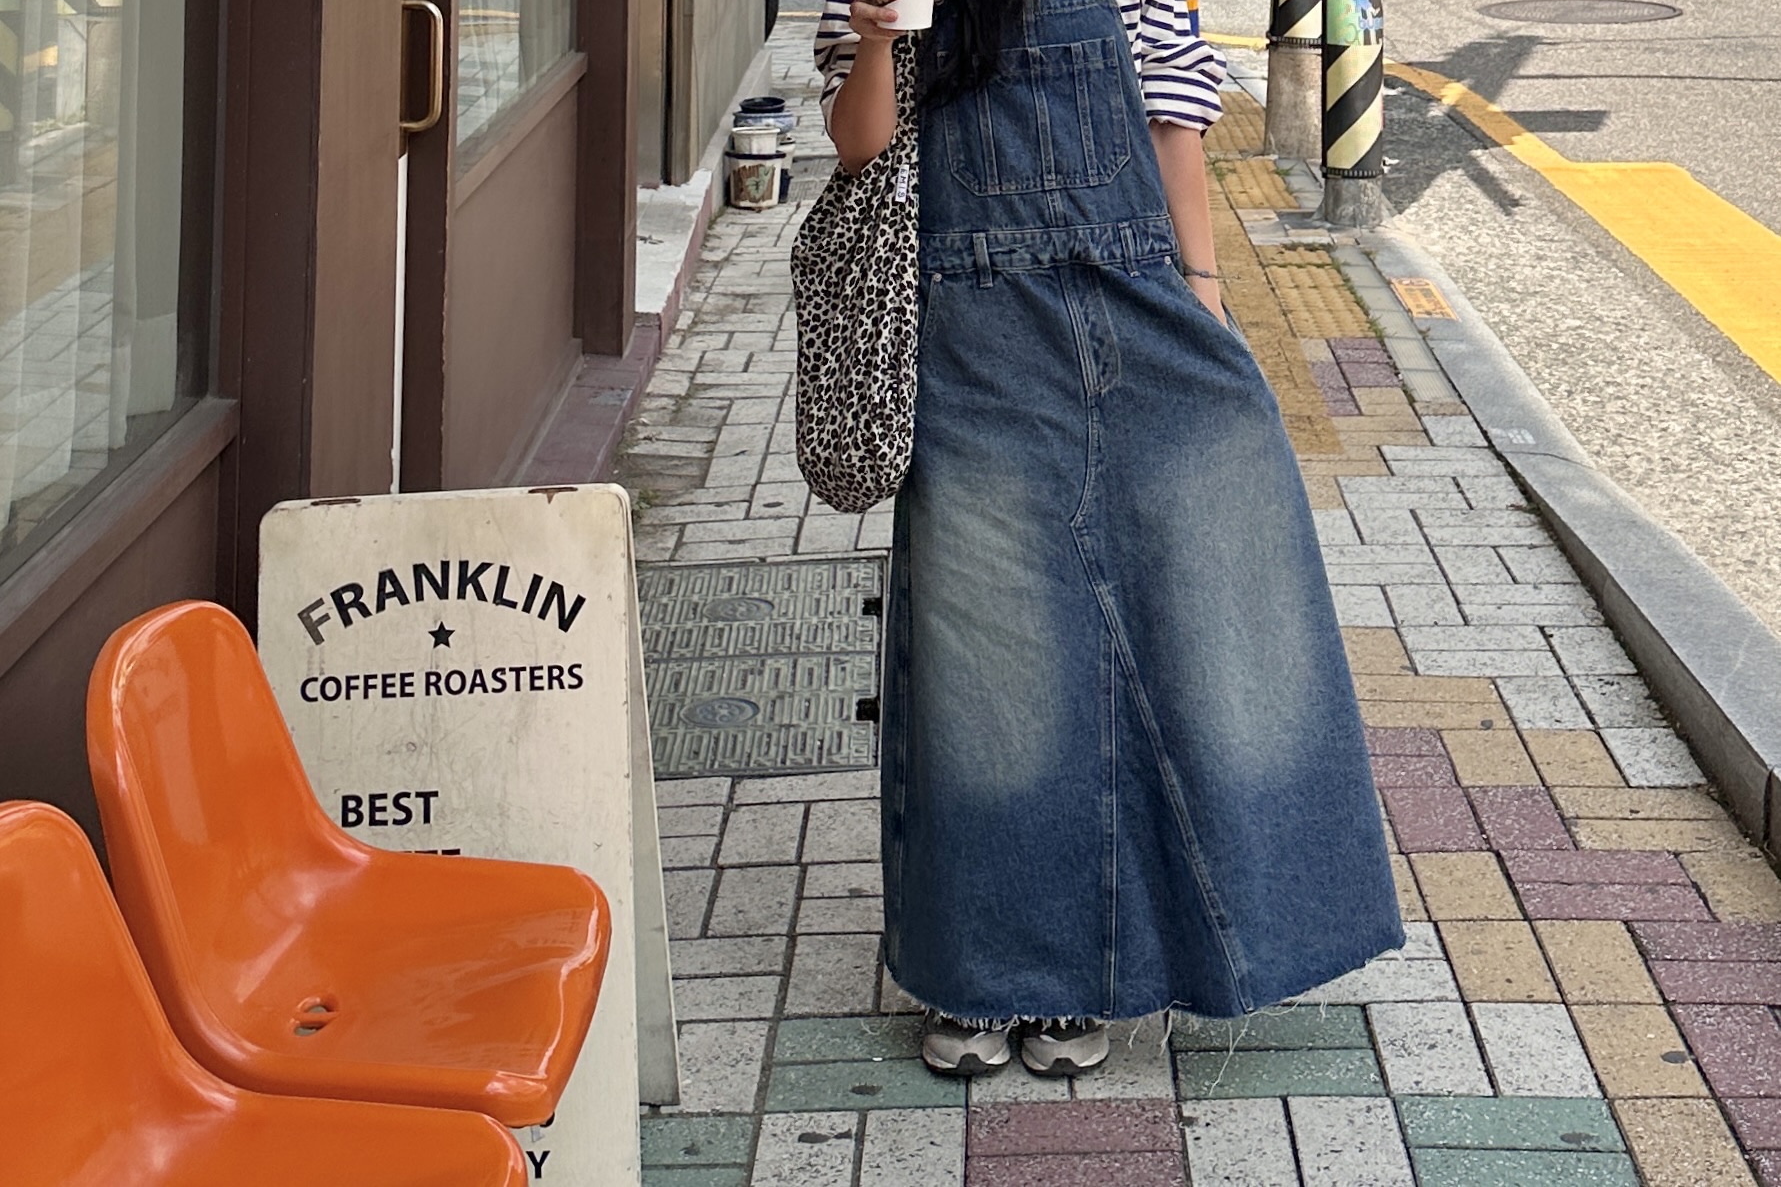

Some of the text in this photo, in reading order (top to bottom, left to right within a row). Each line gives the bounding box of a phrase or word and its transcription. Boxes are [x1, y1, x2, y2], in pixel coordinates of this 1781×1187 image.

[297, 559, 587, 646] FRANKLIN
[299, 663, 584, 704] COFFEE ROASTERS
[340, 790, 439, 828] BEST
